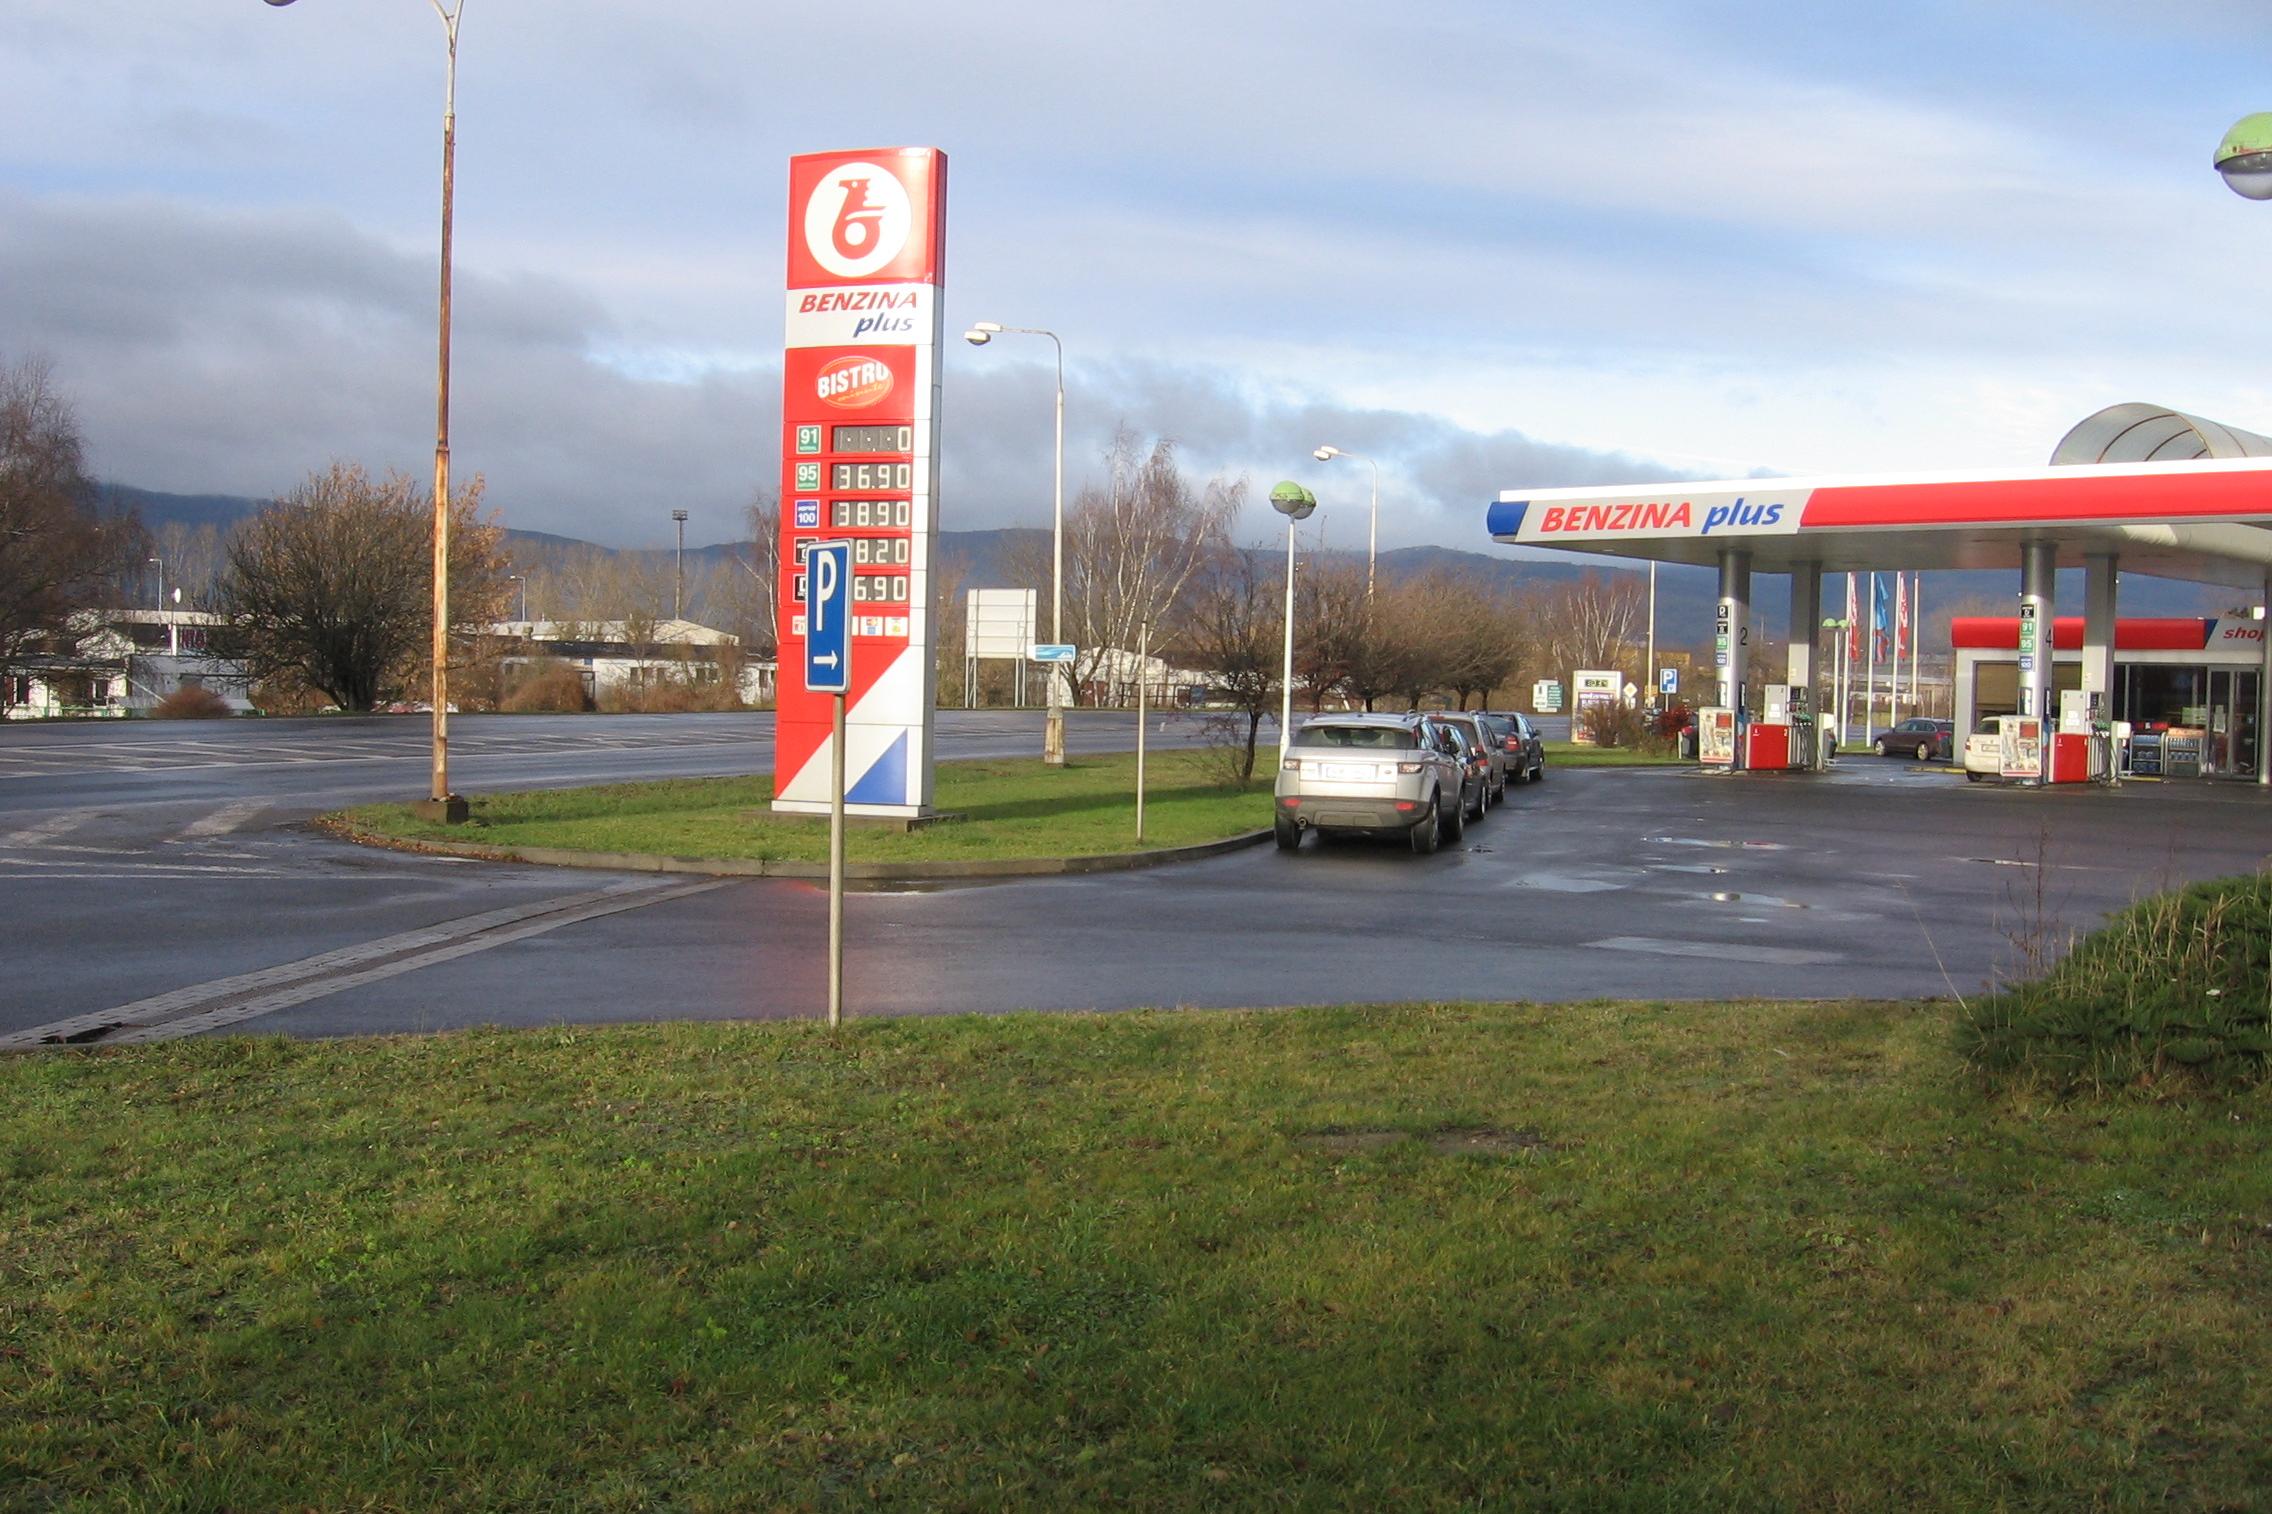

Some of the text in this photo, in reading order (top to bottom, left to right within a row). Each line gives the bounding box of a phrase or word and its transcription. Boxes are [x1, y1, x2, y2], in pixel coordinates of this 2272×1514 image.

[800, 291, 917, 313] BENZINA
[853, 312, 915, 338] plus
[817, 361, 889, 399] BISTRO
[800, 428, 817, 444] 91
[798, 464, 910, 489] 95 36.90
[798, 501, 909, 526] 100 38.90
[1540, 498, 1784, 535] BENZINA plus
[855, 539, 908, 563] 8.20
[816, 550, 837, 631] P
[854, 576, 906, 601] 6.90
[1740, 626, 1748, 646] 2
[2045, 628, 2052, 648] 4
[1663, 671, 1673, 684] P
